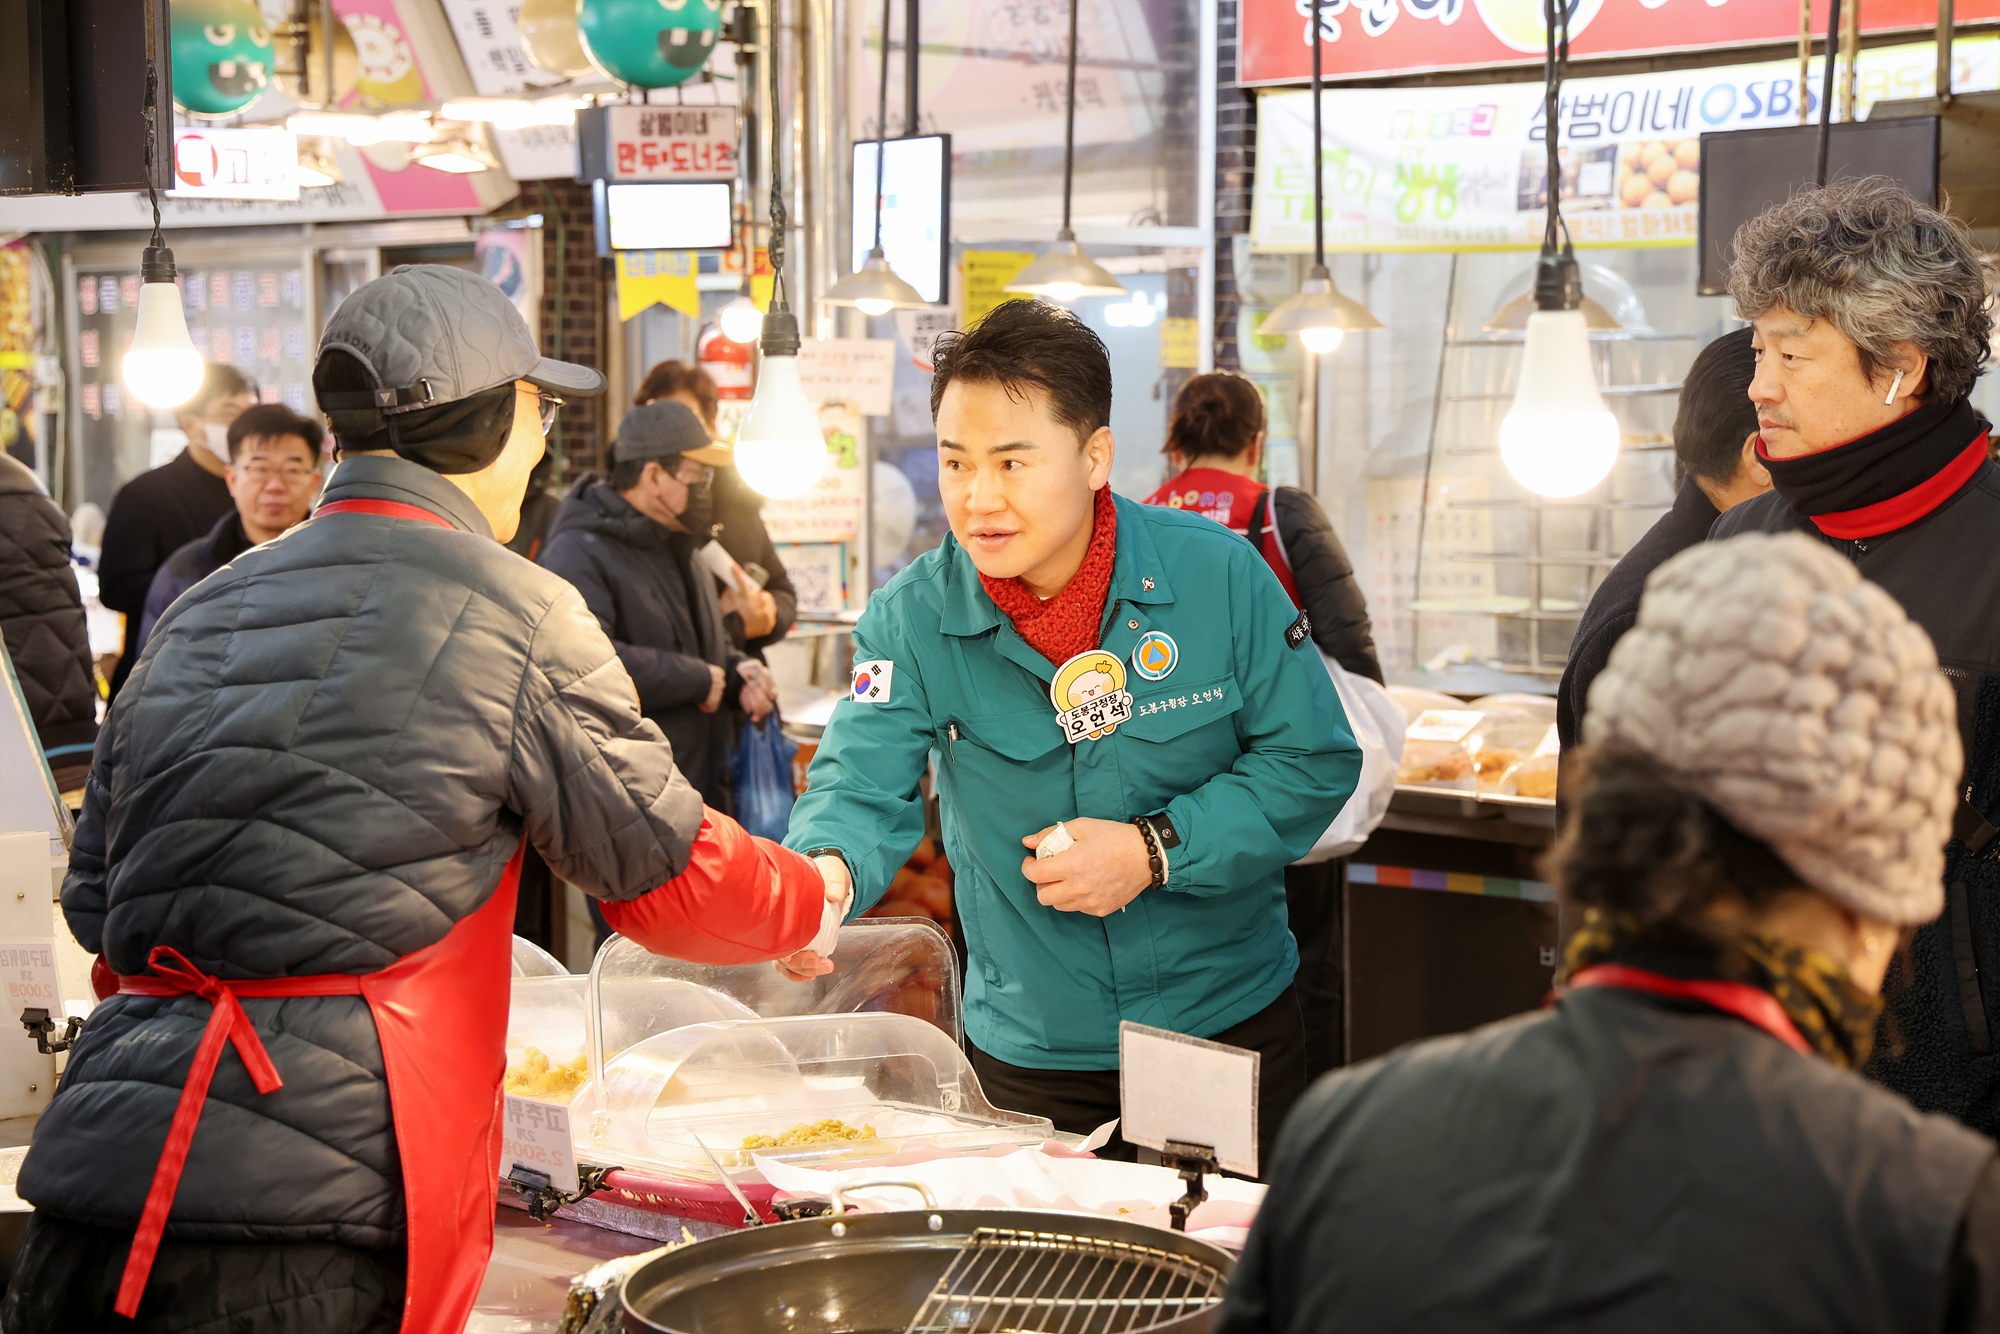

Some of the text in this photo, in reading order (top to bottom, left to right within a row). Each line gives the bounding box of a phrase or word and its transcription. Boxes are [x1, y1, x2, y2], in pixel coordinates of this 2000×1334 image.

[640, 112, 708, 136] 상범이네
[1528, 86, 1694, 141] 상범이네
[324, 331, 371, 355] EASON
